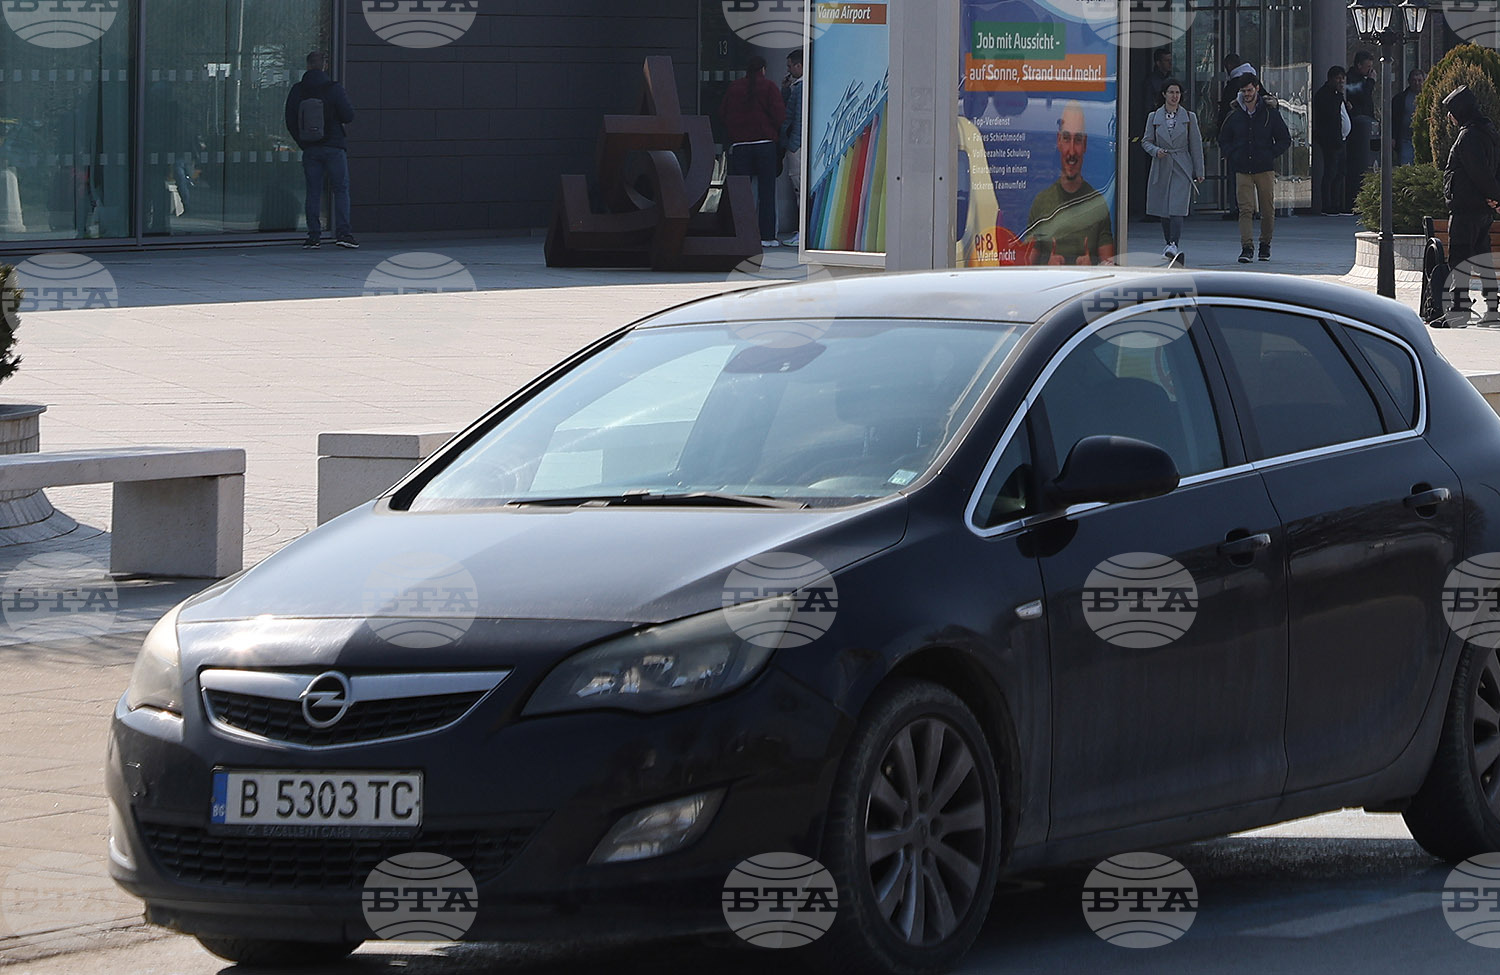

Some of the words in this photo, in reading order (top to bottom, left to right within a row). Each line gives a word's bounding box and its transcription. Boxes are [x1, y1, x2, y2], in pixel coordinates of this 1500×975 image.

[817, 4, 840, 19] Varna
[841, 4, 872, 23] Airport
[976, 32, 994, 49] Job
[996, 32, 1012, 49] mit
[1013, 32, 1054, 50] Aussicht
[969, 64, 986, 81] auf
[987, 64, 1020, 83] Sonne,
[1022, 64, 1053, 81] Strand
[1055, 65, 1074, 81] und
[1074, 65, 1102, 81] mehr!
[999, 248, 1016, 261] nicht
[213, 804, 226, 817] BG
[240, 779, 259, 818] B
[276, 780, 358, 819] 5303
[368, 781, 413, 820] TC
[263, 825, 318, 838] EXCELLENT
[322, 826, 351, 838] CARS
